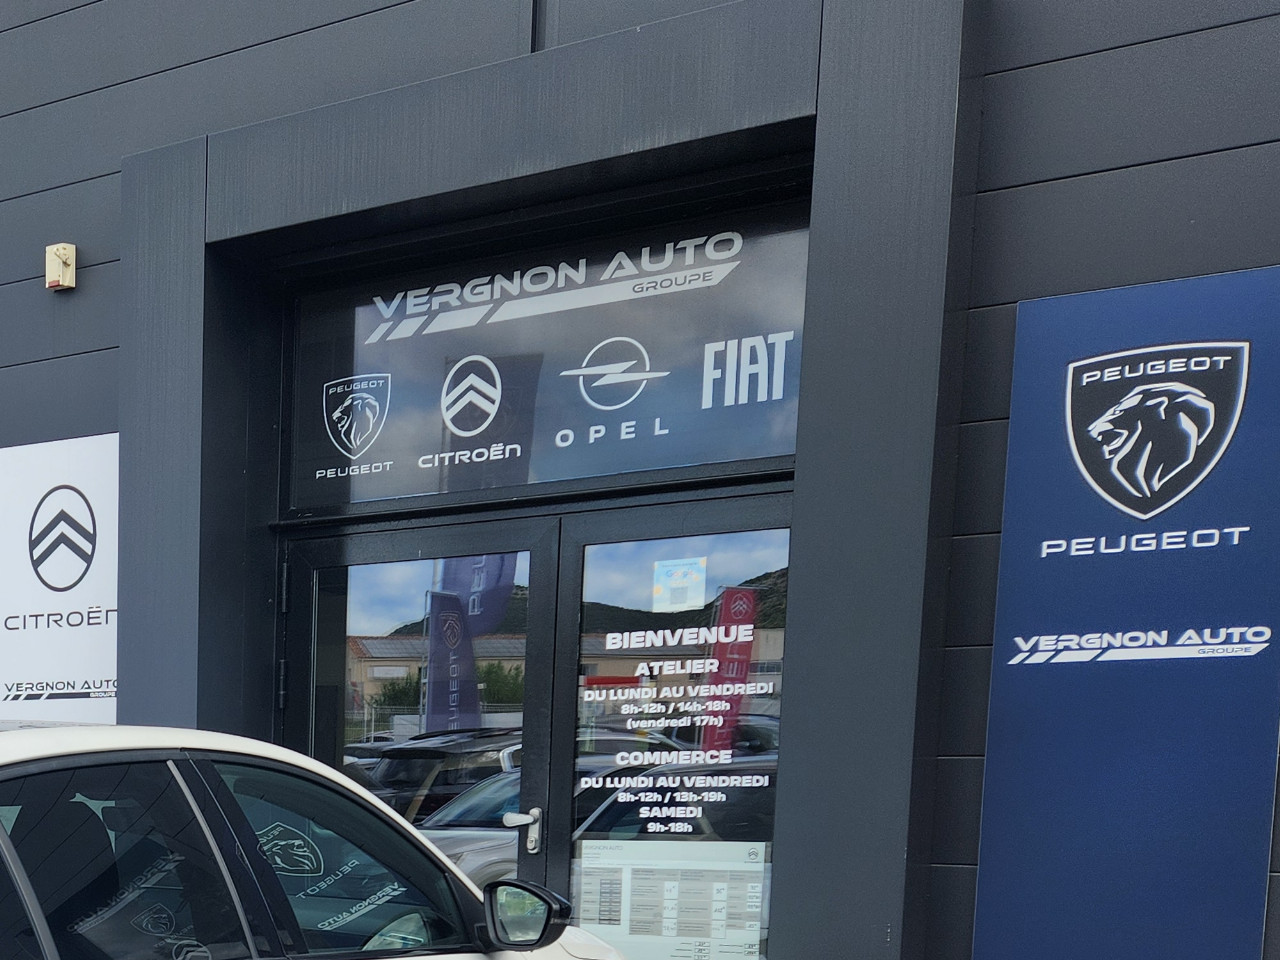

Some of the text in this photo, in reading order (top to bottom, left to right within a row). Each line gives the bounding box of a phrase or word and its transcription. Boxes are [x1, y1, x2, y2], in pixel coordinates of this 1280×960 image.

[372, 231, 744, 320] VERGNON AUTO
[632, 271, 714, 293] GROUPE
[702, 331, 795, 409] FIAT
[1081, 356, 1232, 386] PEUGEOT
[328, 379, 385, 395] PEUGEOT
[555, 418, 669, 448] OPEL
[316, 461, 394, 479] PEUGEOT
[1041, 526, 1250, 558] PEUGEOT
[605, 624, 754, 650] BIENVENUE
[1013, 626, 1271, 652] VERGNON AUTO
[1197, 646, 1252, 655] GROUPE
[634, 658, 720, 676] ATELIER
[4, 680, 75, 692] VERGNON
[583, 682, 774, 701] DU LUNDI AU VENDREDI
[620, 702, 666, 715] 8h-12h
[677, 700, 730, 712] 14h-18h
[626, 715, 723, 730] (vendredi 17h)
[615, 750, 733, 765] COMMERCE
[580, 775, 769, 788] DU LUNDI AU VENDREDI
[617, 791, 662, 802] 8h-12h
[673, 791, 726, 802] 13h-19h
[639, 806, 703, 818] SAMEDI
[647, 822, 693, 833] 9h-18h
